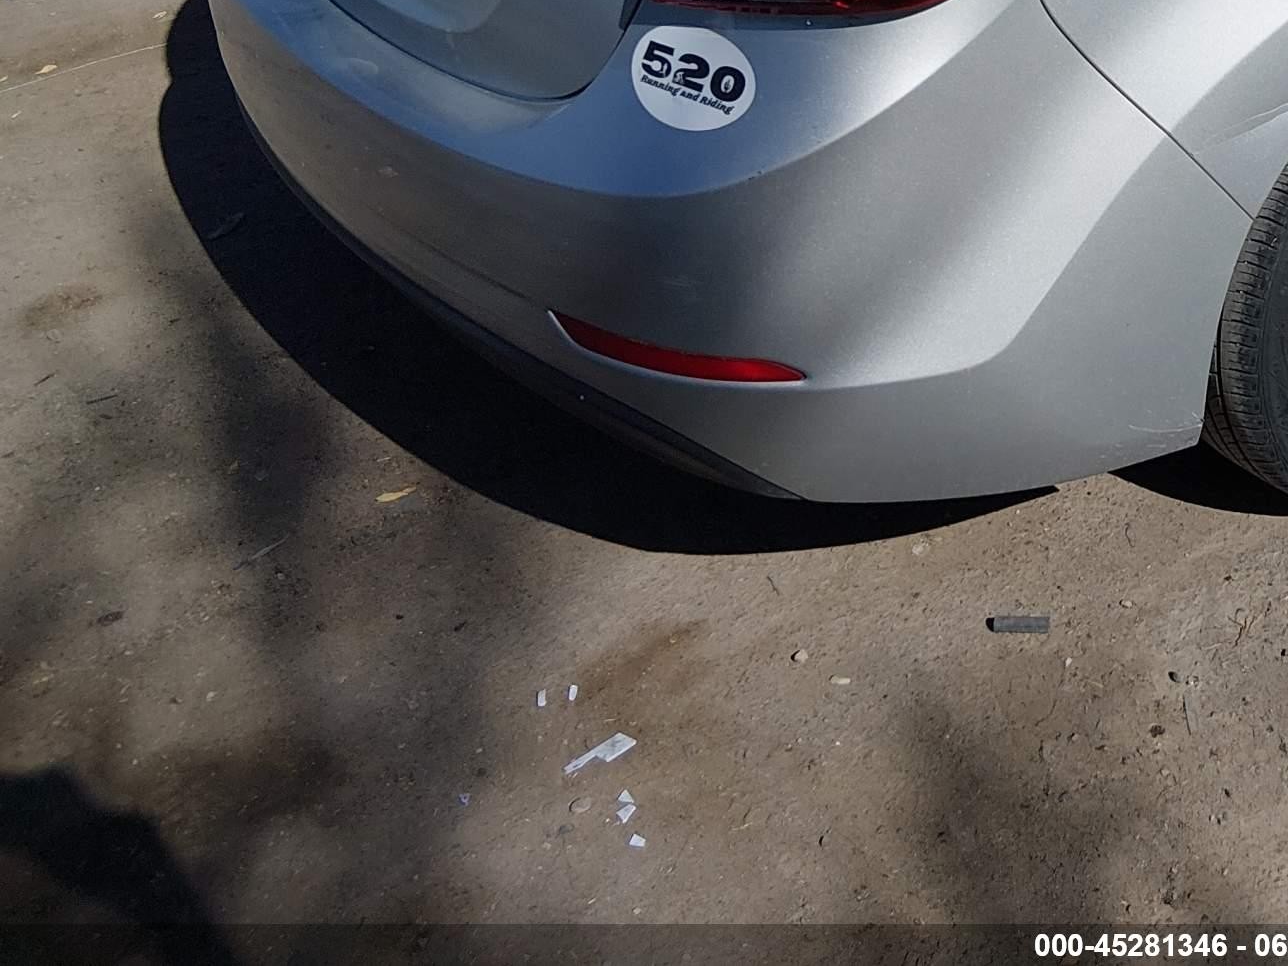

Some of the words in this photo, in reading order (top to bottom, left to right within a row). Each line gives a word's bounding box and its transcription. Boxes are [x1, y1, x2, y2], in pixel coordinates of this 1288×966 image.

[640, 74, 681, 97] Running
[680, 90, 701, 102] and
[699, 96, 735, 115] Riding
[641, 40, 746, 102] 520
